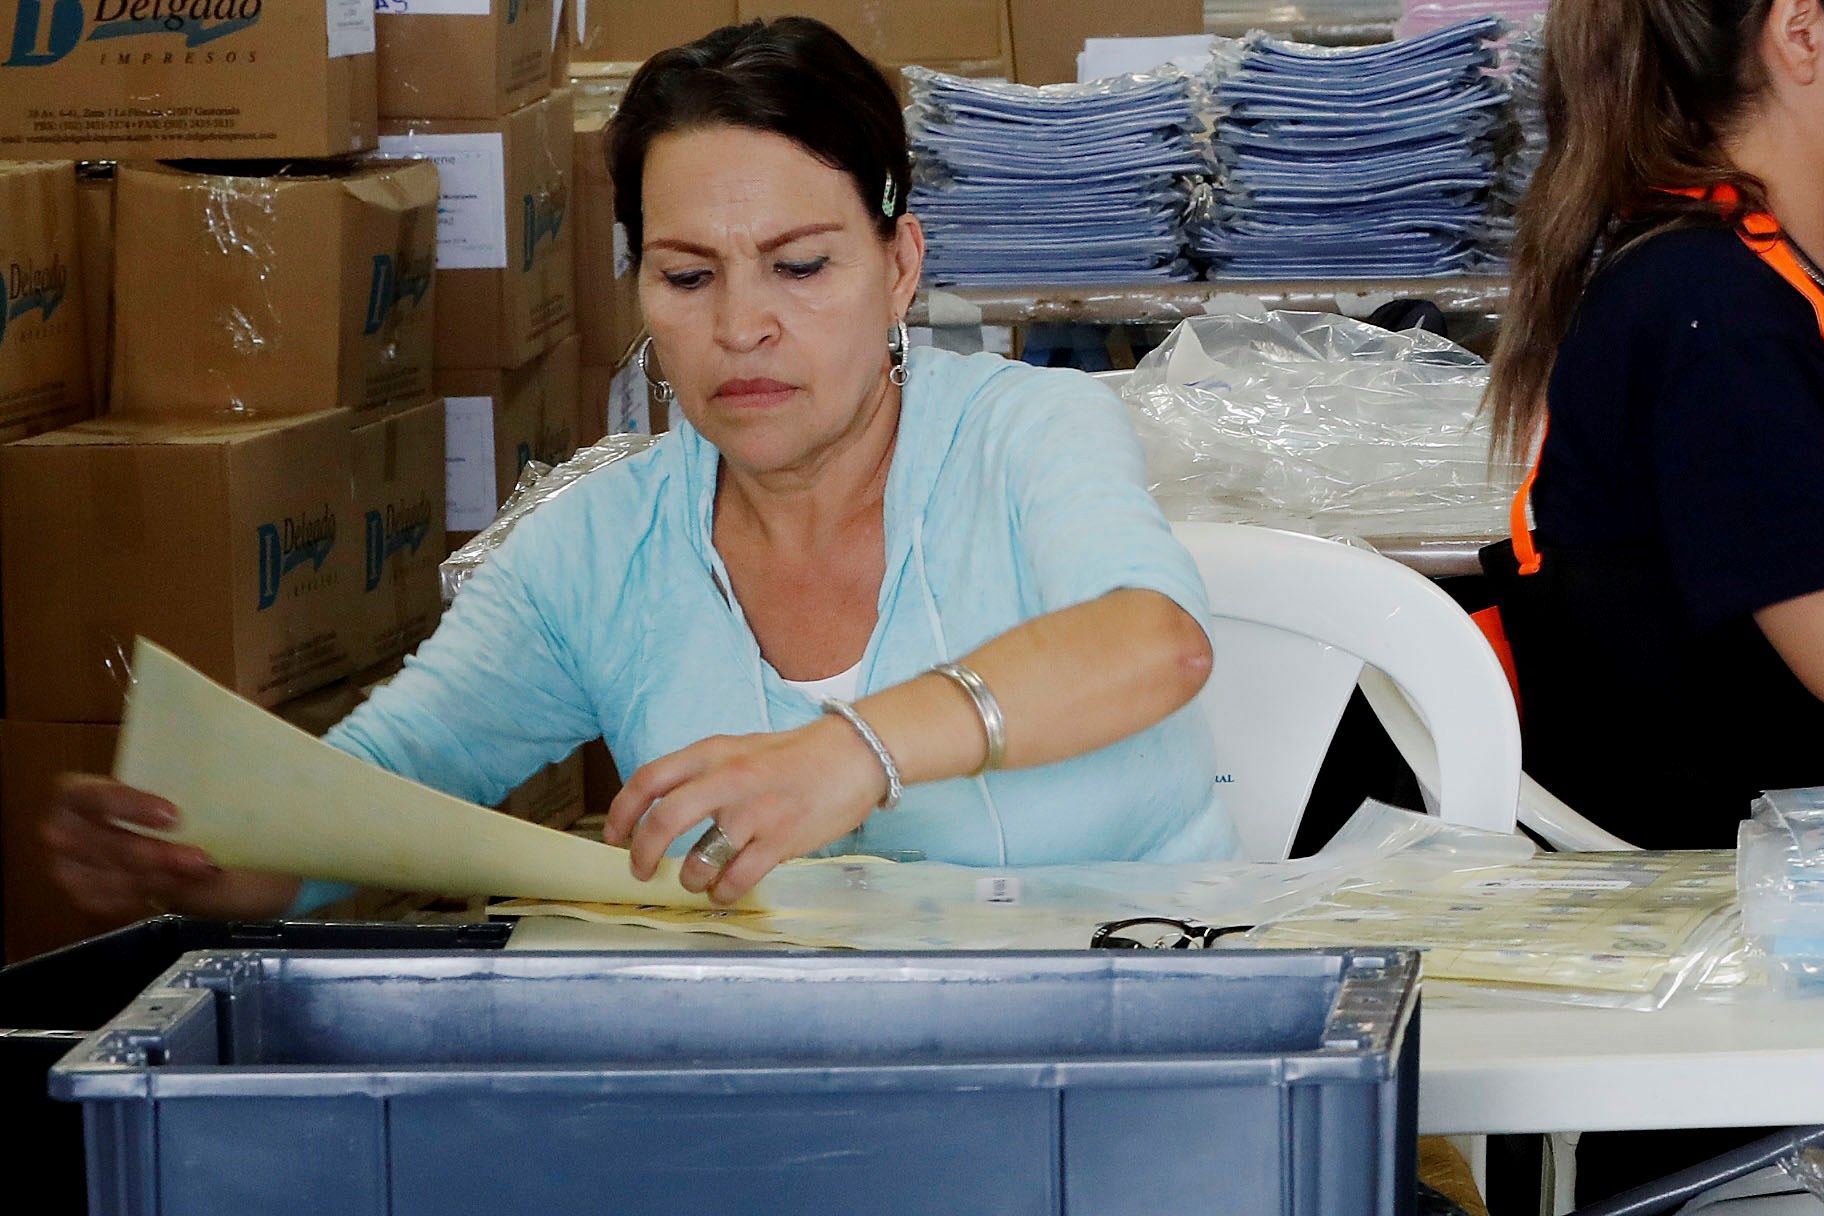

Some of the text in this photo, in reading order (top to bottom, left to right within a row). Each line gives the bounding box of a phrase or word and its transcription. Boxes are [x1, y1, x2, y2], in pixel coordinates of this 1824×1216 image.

[100, 50, 257, 64] IMPRESOS
[10, 258, 66, 300] Delgado
[282, 504, 337, 556] Delgado
